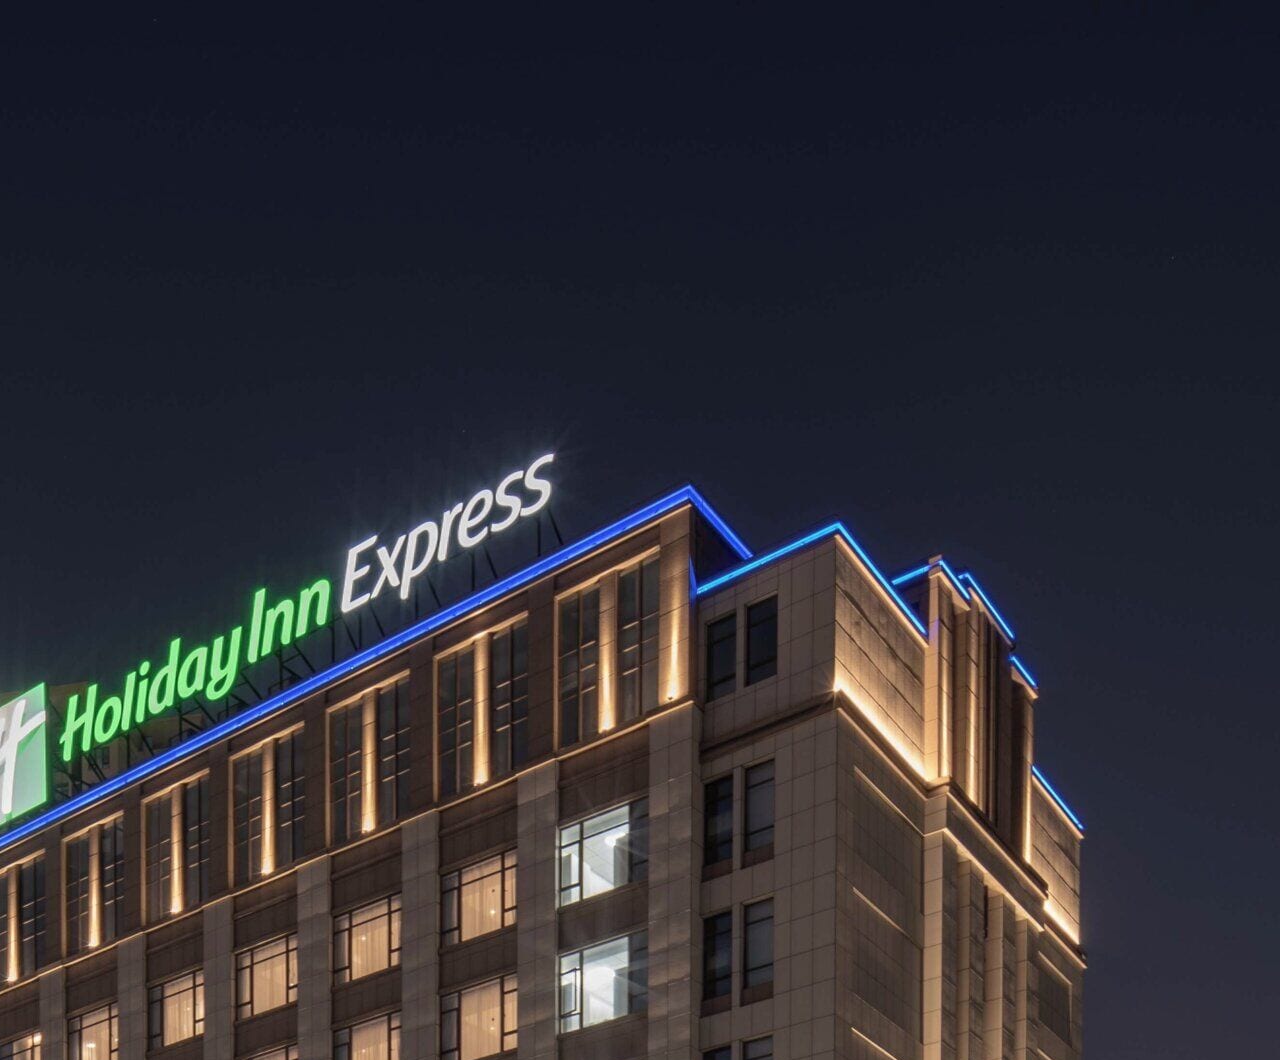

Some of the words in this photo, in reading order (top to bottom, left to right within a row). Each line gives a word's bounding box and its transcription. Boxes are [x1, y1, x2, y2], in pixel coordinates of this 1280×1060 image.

[60, 628, 242, 762] Holiday
[246, 575, 330, 664] Inn
[340, 452, 556, 613] Express
